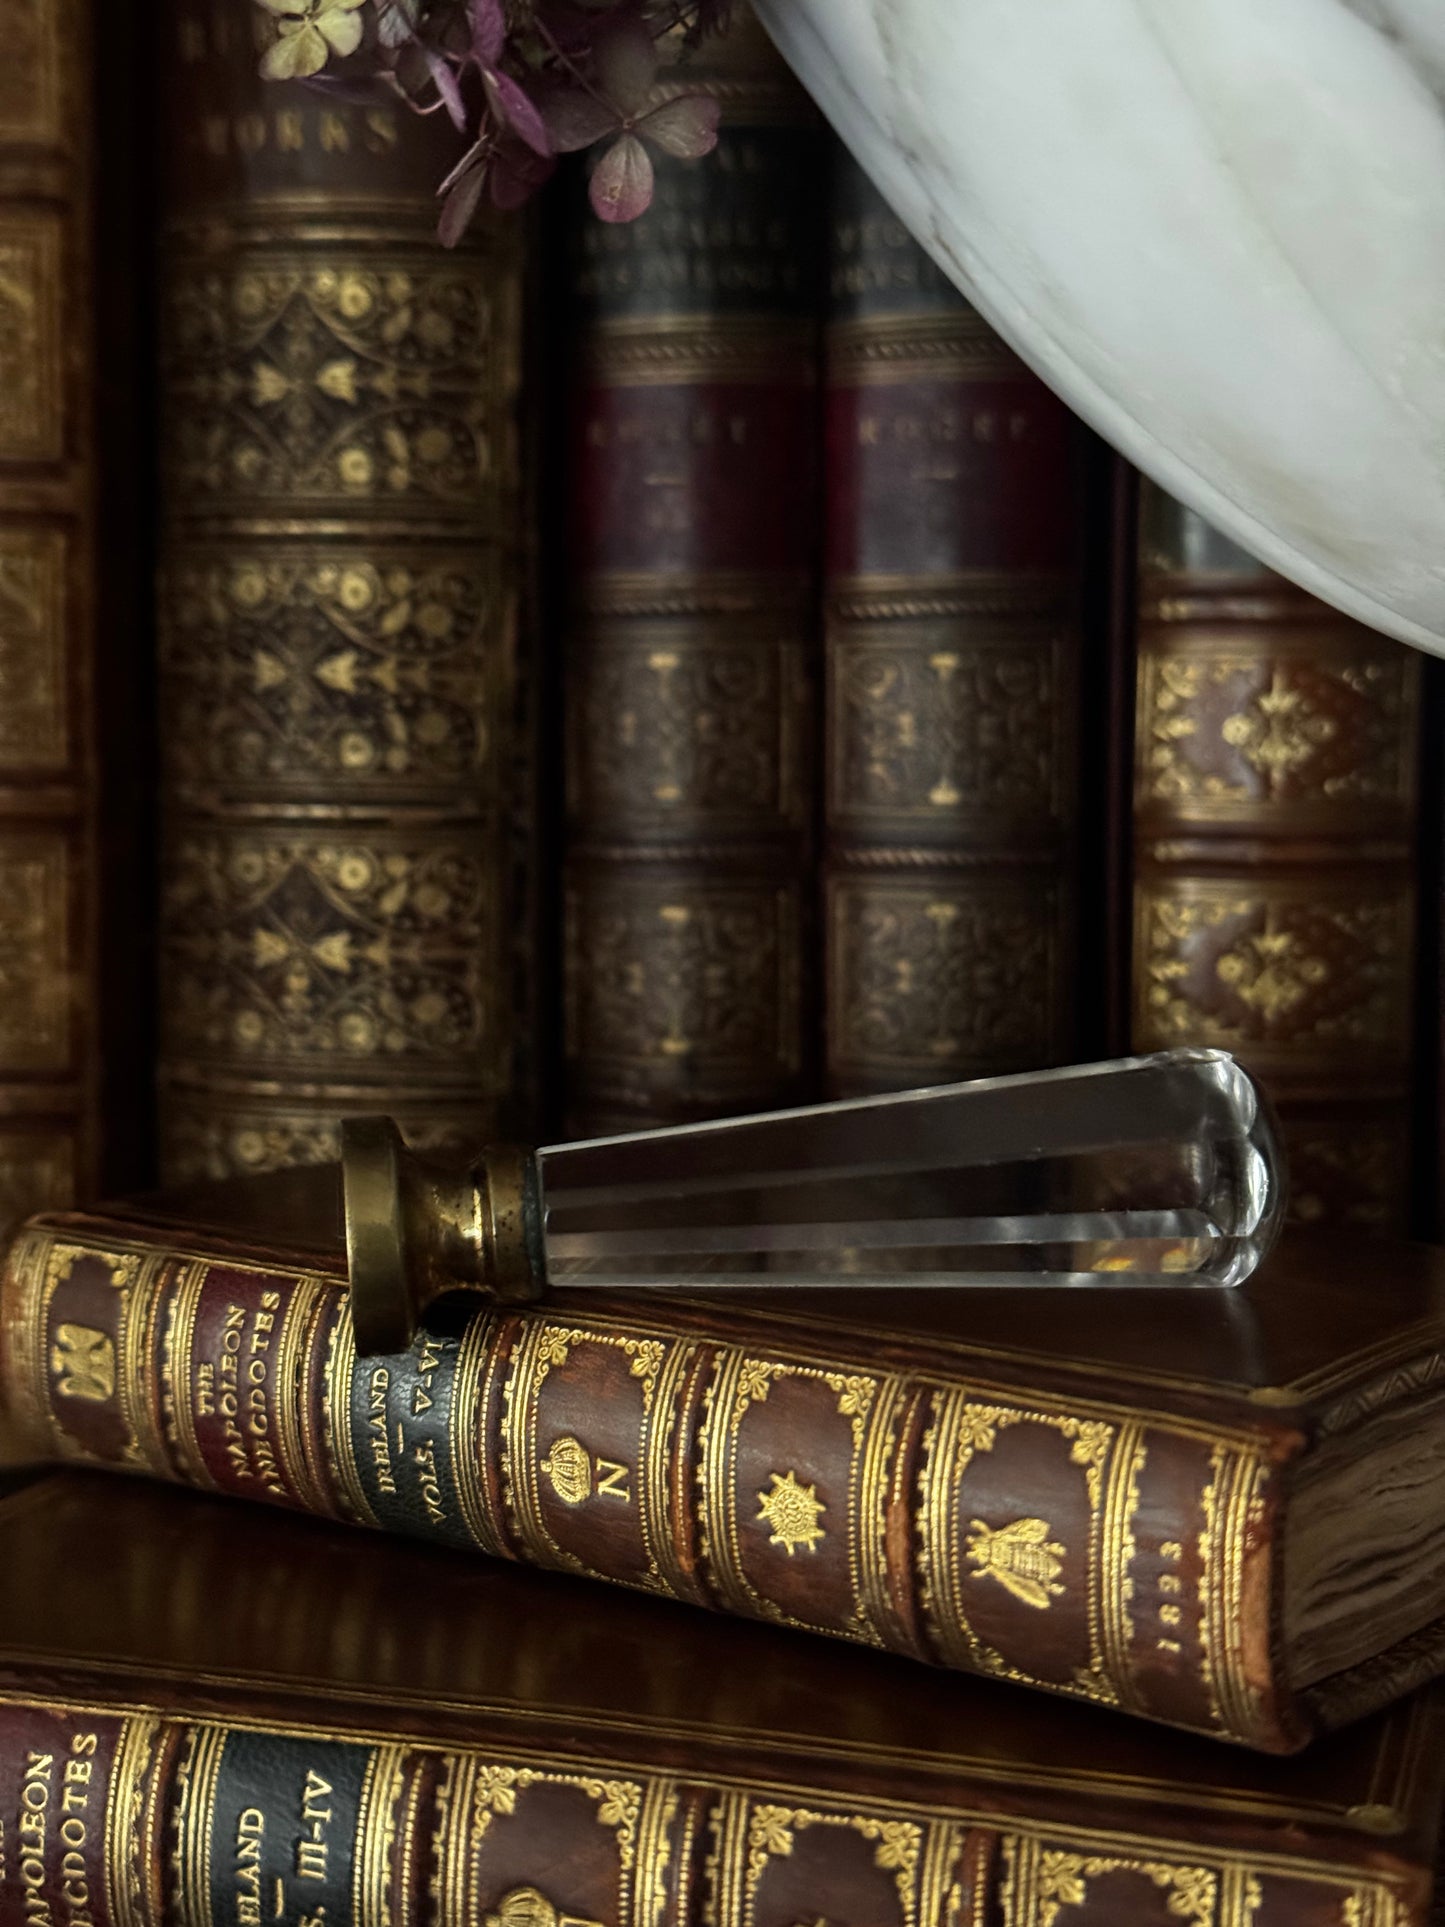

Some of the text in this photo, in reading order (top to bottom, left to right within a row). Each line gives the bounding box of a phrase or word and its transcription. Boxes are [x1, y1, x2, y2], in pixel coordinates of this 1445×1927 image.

[198, 1363, 215, 1415] THE
[221, 1304, 251, 1478] NAPOLEON
[249, 1291, 287, 1496] ANECDOTES
[370, 1368, 397, 1493] IRELAND
[415, 1440, 447, 1524] VOLS.
[596, 1457, 630, 1503] N
[299, 1769, 333, 1882] III-IV
